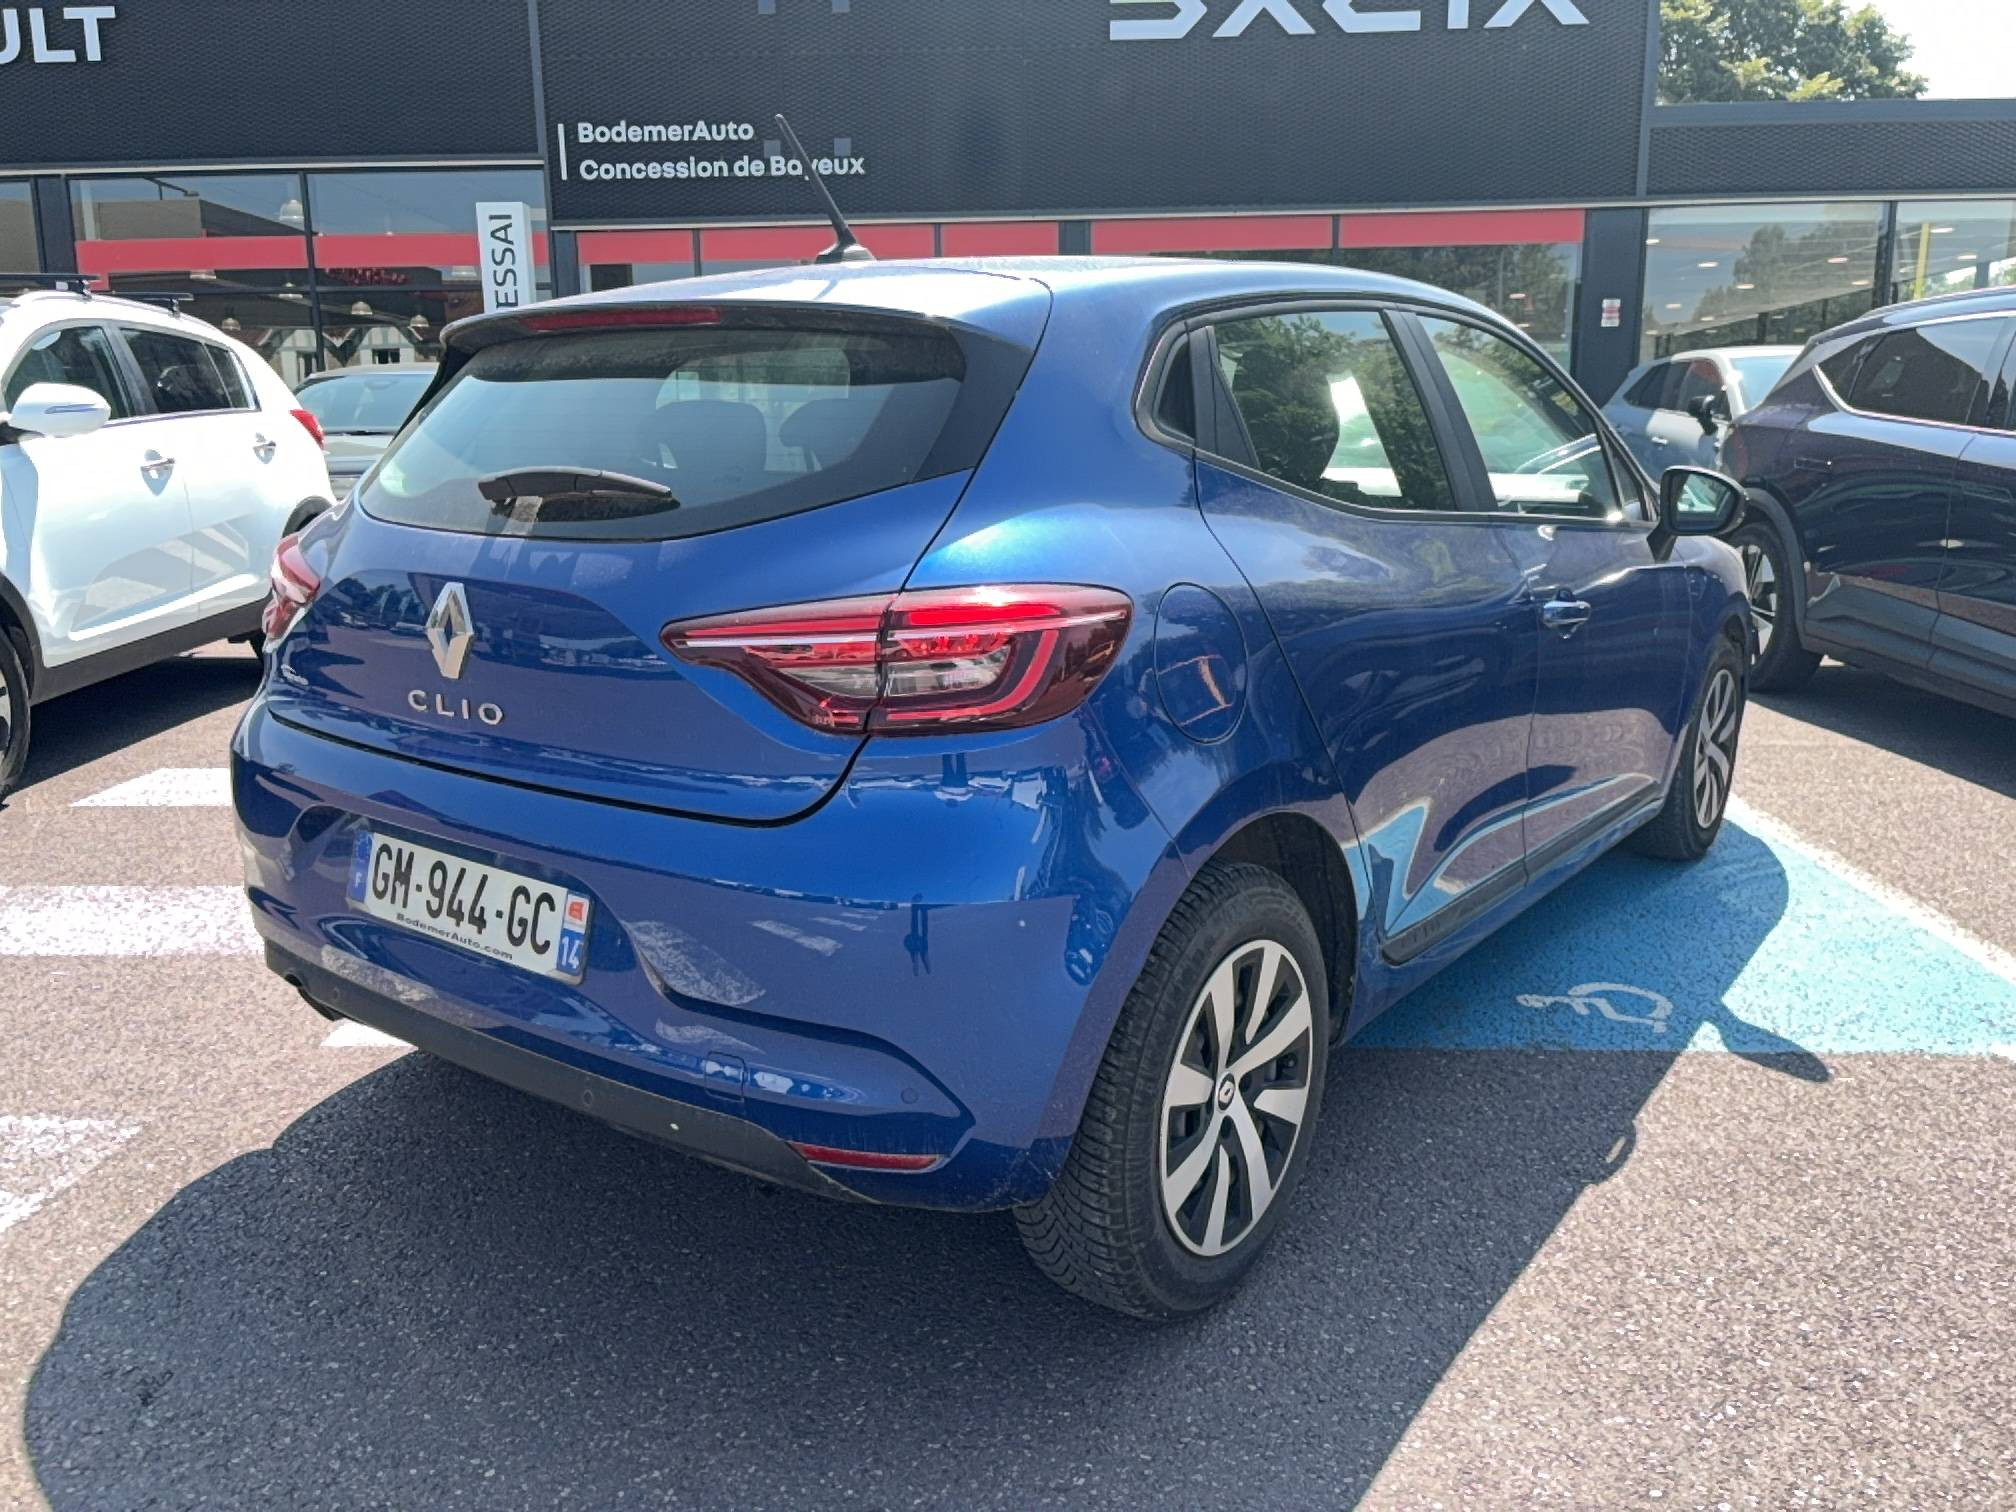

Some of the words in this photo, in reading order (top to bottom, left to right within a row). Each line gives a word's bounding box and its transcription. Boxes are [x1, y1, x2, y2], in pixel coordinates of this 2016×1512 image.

[576, 119, 755, 144] BodemerAuto
[578, 155, 729, 181] Concession
[733, 155, 765, 177] de
[488, 214, 519, 309] ESSAI
[407, 689, 503, 725] CLIO
[372, 843, 556, 955] GM-944-GC
[396, 912, 513, 961] BodemerAuto.com
[561, 935, 582, 969] 14
